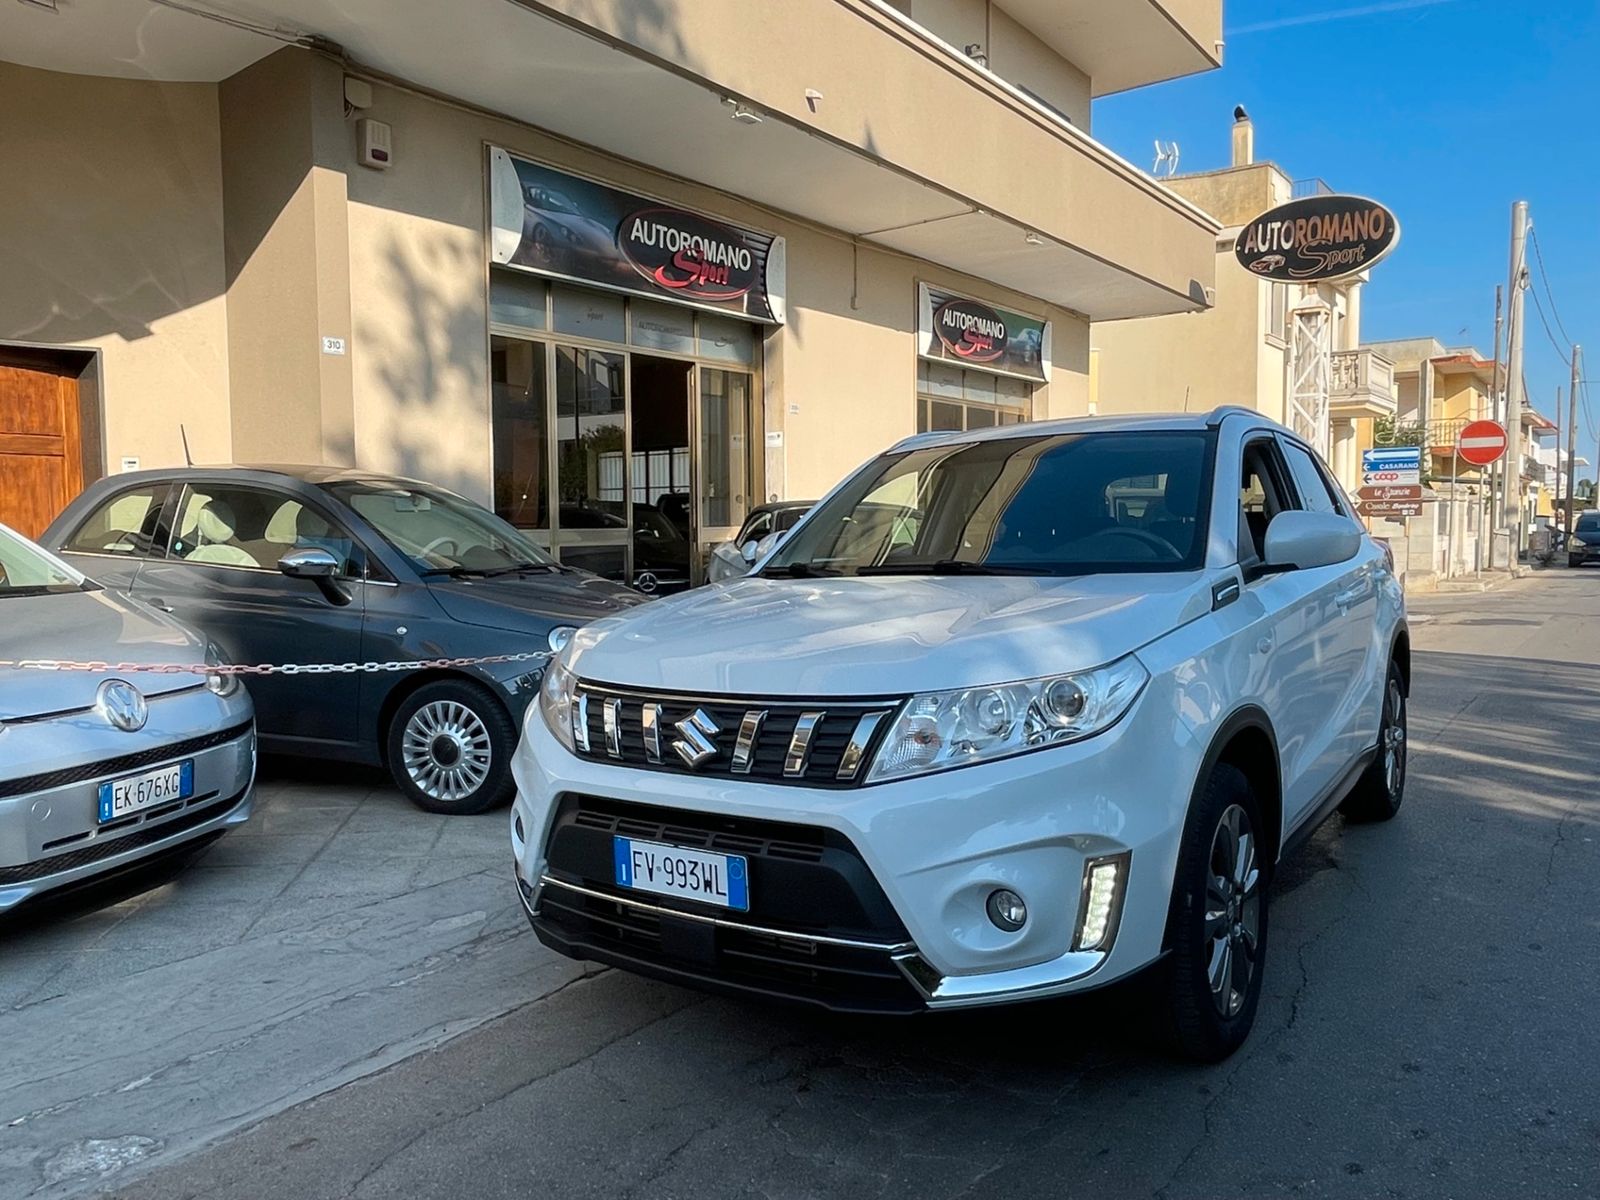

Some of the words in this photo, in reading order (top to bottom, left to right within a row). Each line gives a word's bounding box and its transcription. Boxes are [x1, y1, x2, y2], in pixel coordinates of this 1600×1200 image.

[630, 217, 752, 271] AUTOROMANO
[1244, 207, 1386, 254] AUTOROMANO
[654, 247, 729, 288] Sport
[1288, 238, 1366, 277] Sport
[942, 308, 1005, 340] AUTOROMANO
[327, 340, 341, 349] 310
[1379, 462, 1419, 470] CASARANO
